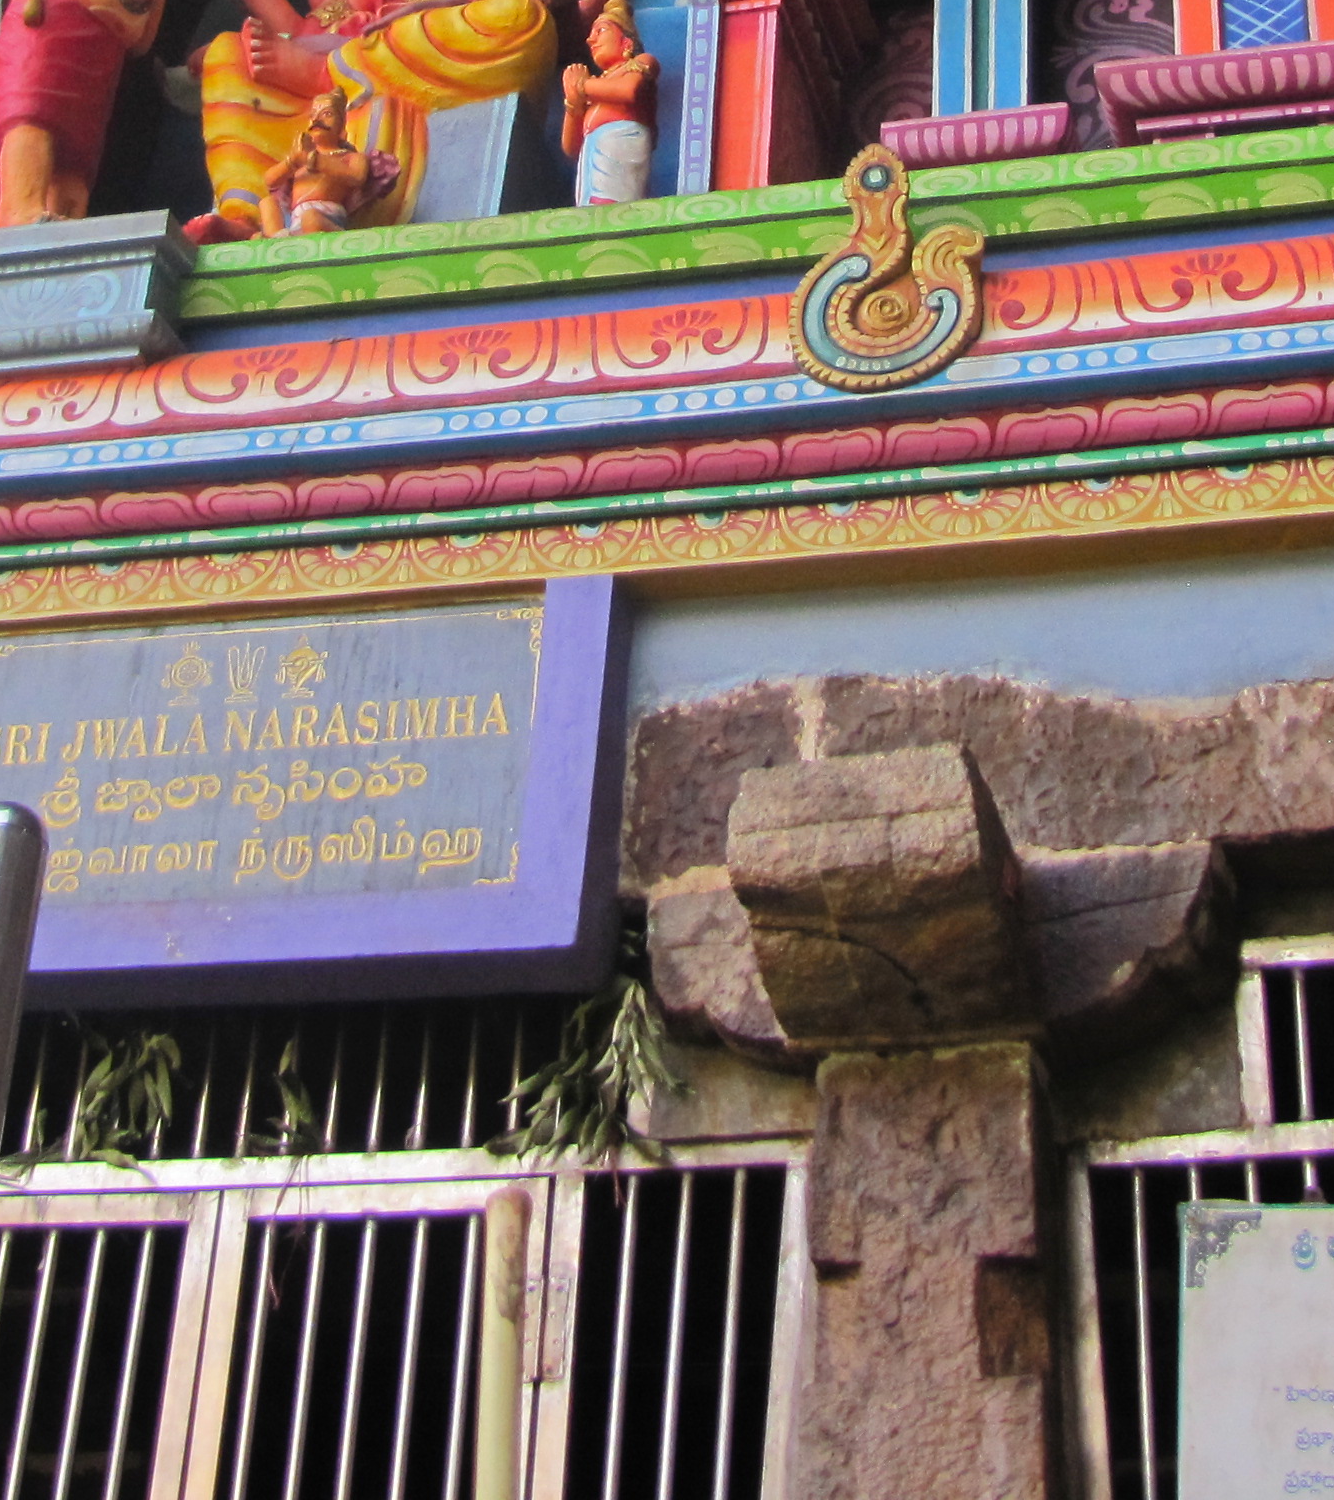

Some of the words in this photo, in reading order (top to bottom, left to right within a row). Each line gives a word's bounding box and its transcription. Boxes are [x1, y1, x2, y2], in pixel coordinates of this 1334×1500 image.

[62, 713, 208, 762] JWALA
[224, 693, 510, 751] NARASIMHA
[40, 766, 82, 828] శ్రీ
[95, 777, 221, 822] జ్వాలా
[1292, 1228, 1318, 1270] శ్రీ
